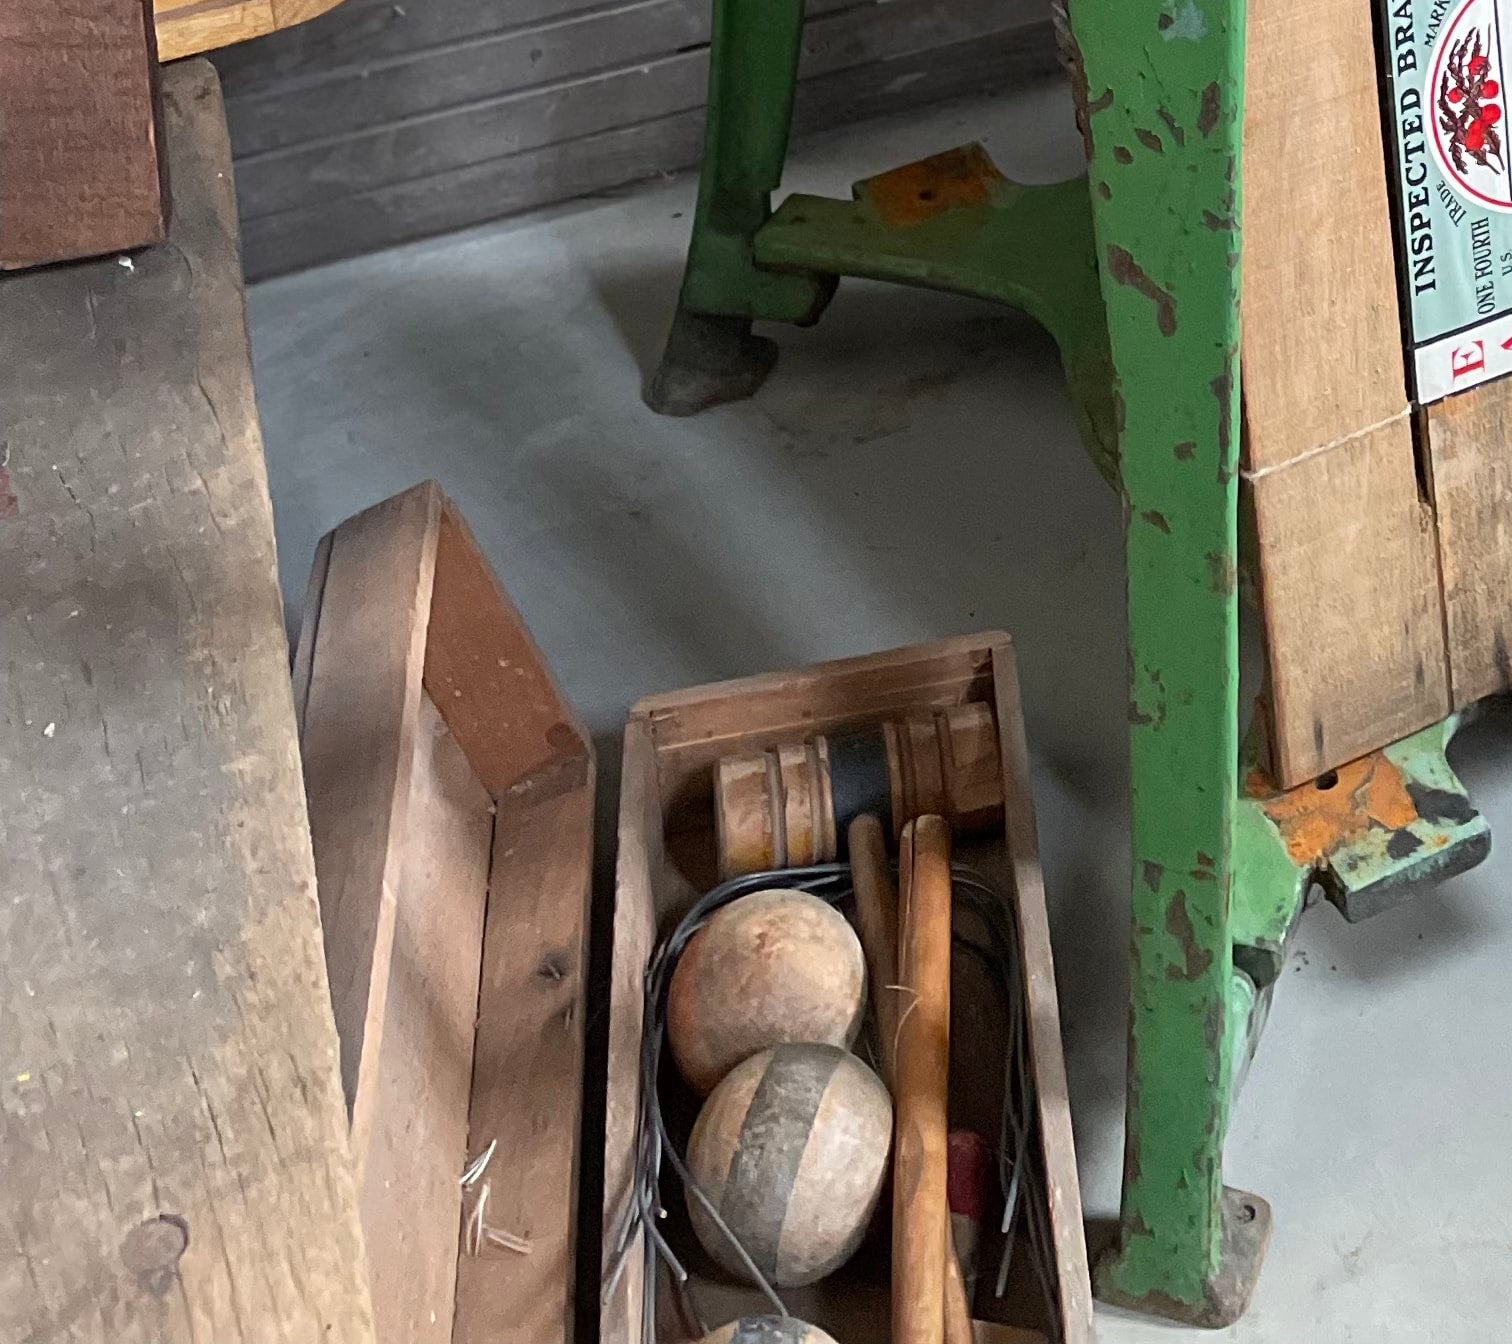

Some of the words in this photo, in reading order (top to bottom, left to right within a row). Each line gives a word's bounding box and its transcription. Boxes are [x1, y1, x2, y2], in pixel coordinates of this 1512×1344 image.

[1401, 87, 1437, 297] INSPECTED
[1436, 179, 1467, 227] TRADE
[1471, 216, 1493, 280] FOURTH
[1476, 280, 1496, 315] ONE
